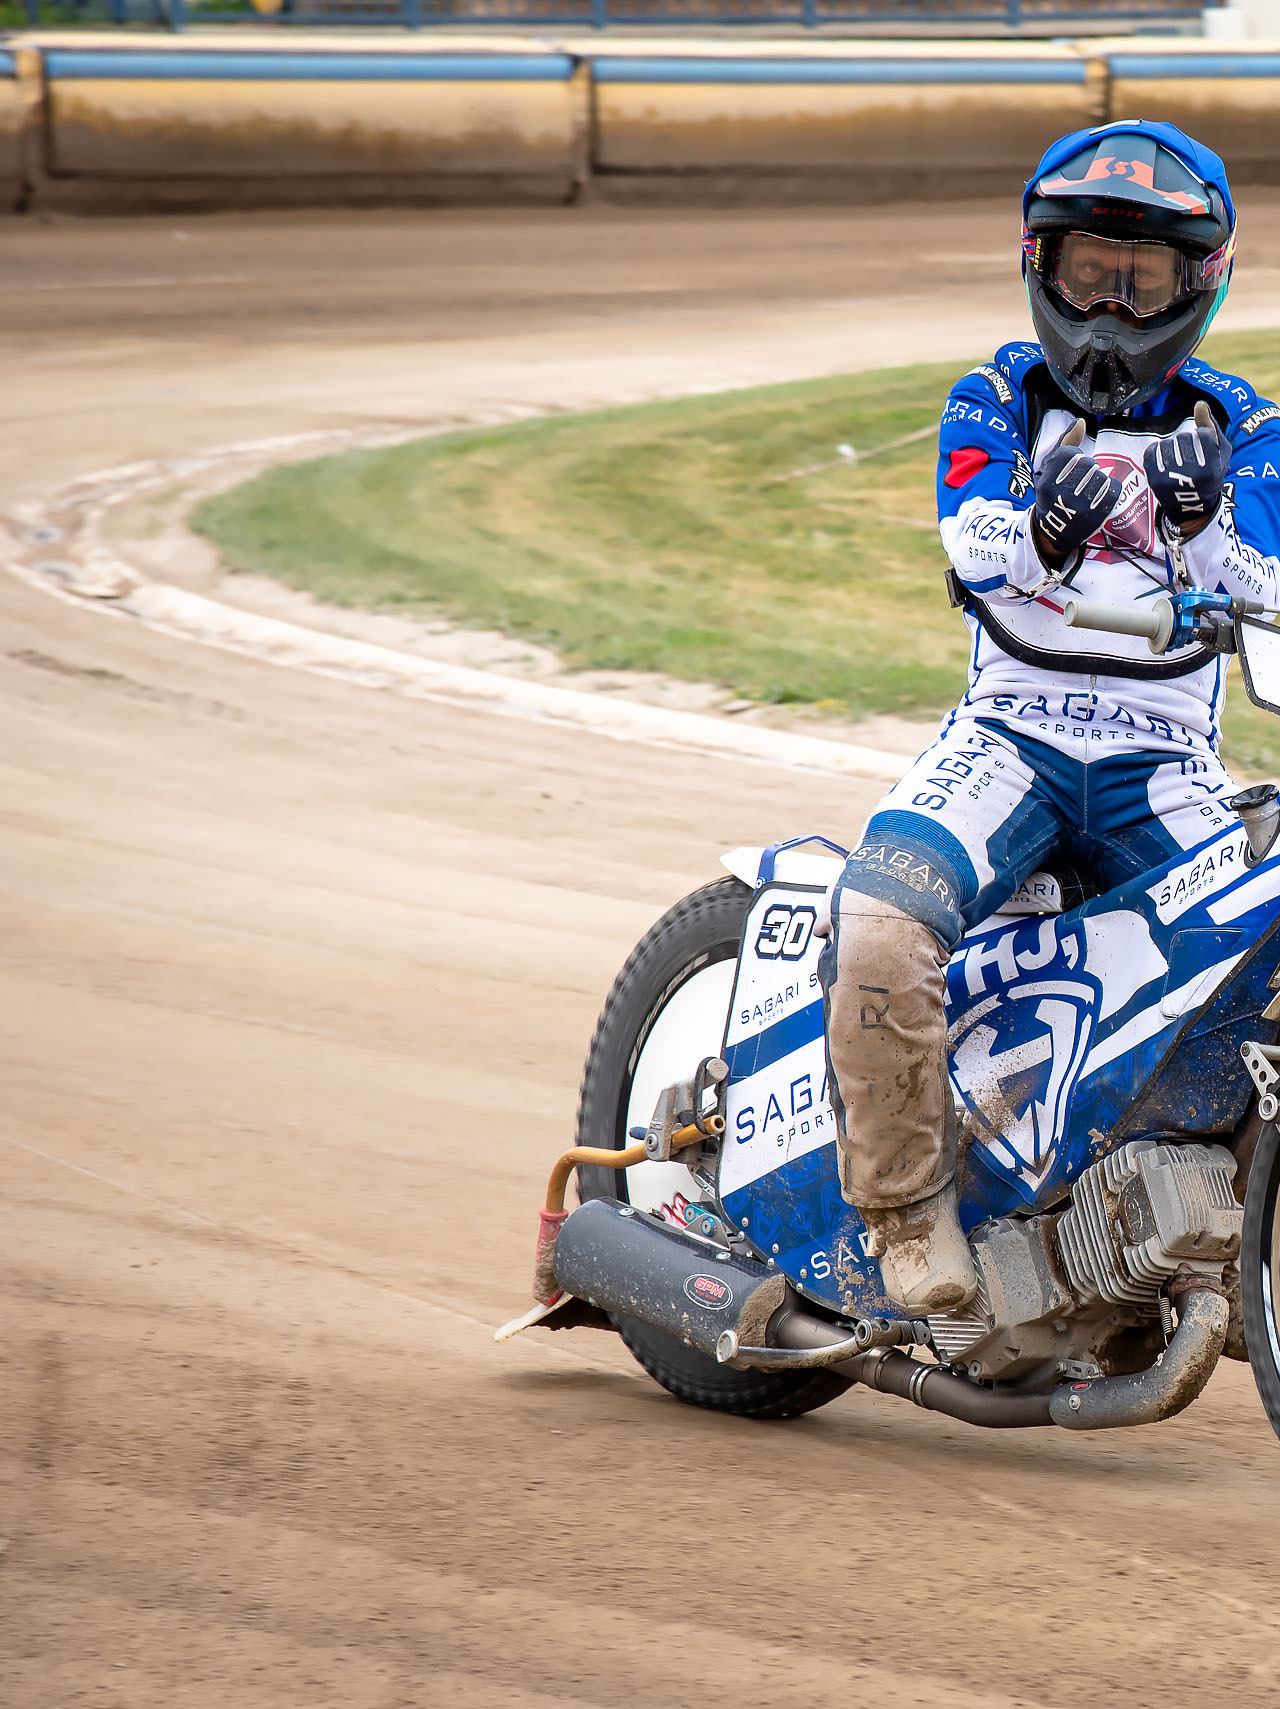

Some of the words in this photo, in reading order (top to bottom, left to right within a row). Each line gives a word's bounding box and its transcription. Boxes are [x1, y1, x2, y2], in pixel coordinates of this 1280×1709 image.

[1033, 237, 1042, 271] OAKLEY
[1168, 471, 1204, 513] FOX
[1040, 494, 1077, 541] FOX
[968, 546, 1007, 564] SPORTS
[1222, 556, 1263, 595] SPORTS
[991, 692, 1193, 747] SAGARI
[850, 846, 956, 912] SAGARI
[1160, 841, 1244, 907] SAGARI
[754, 903, 818, 961] 30
[741, 981, 799, 1025] SAGARI
[776, 1108, 835, 1147] SPORT
[694, 1277, 727, 1299] GPM
